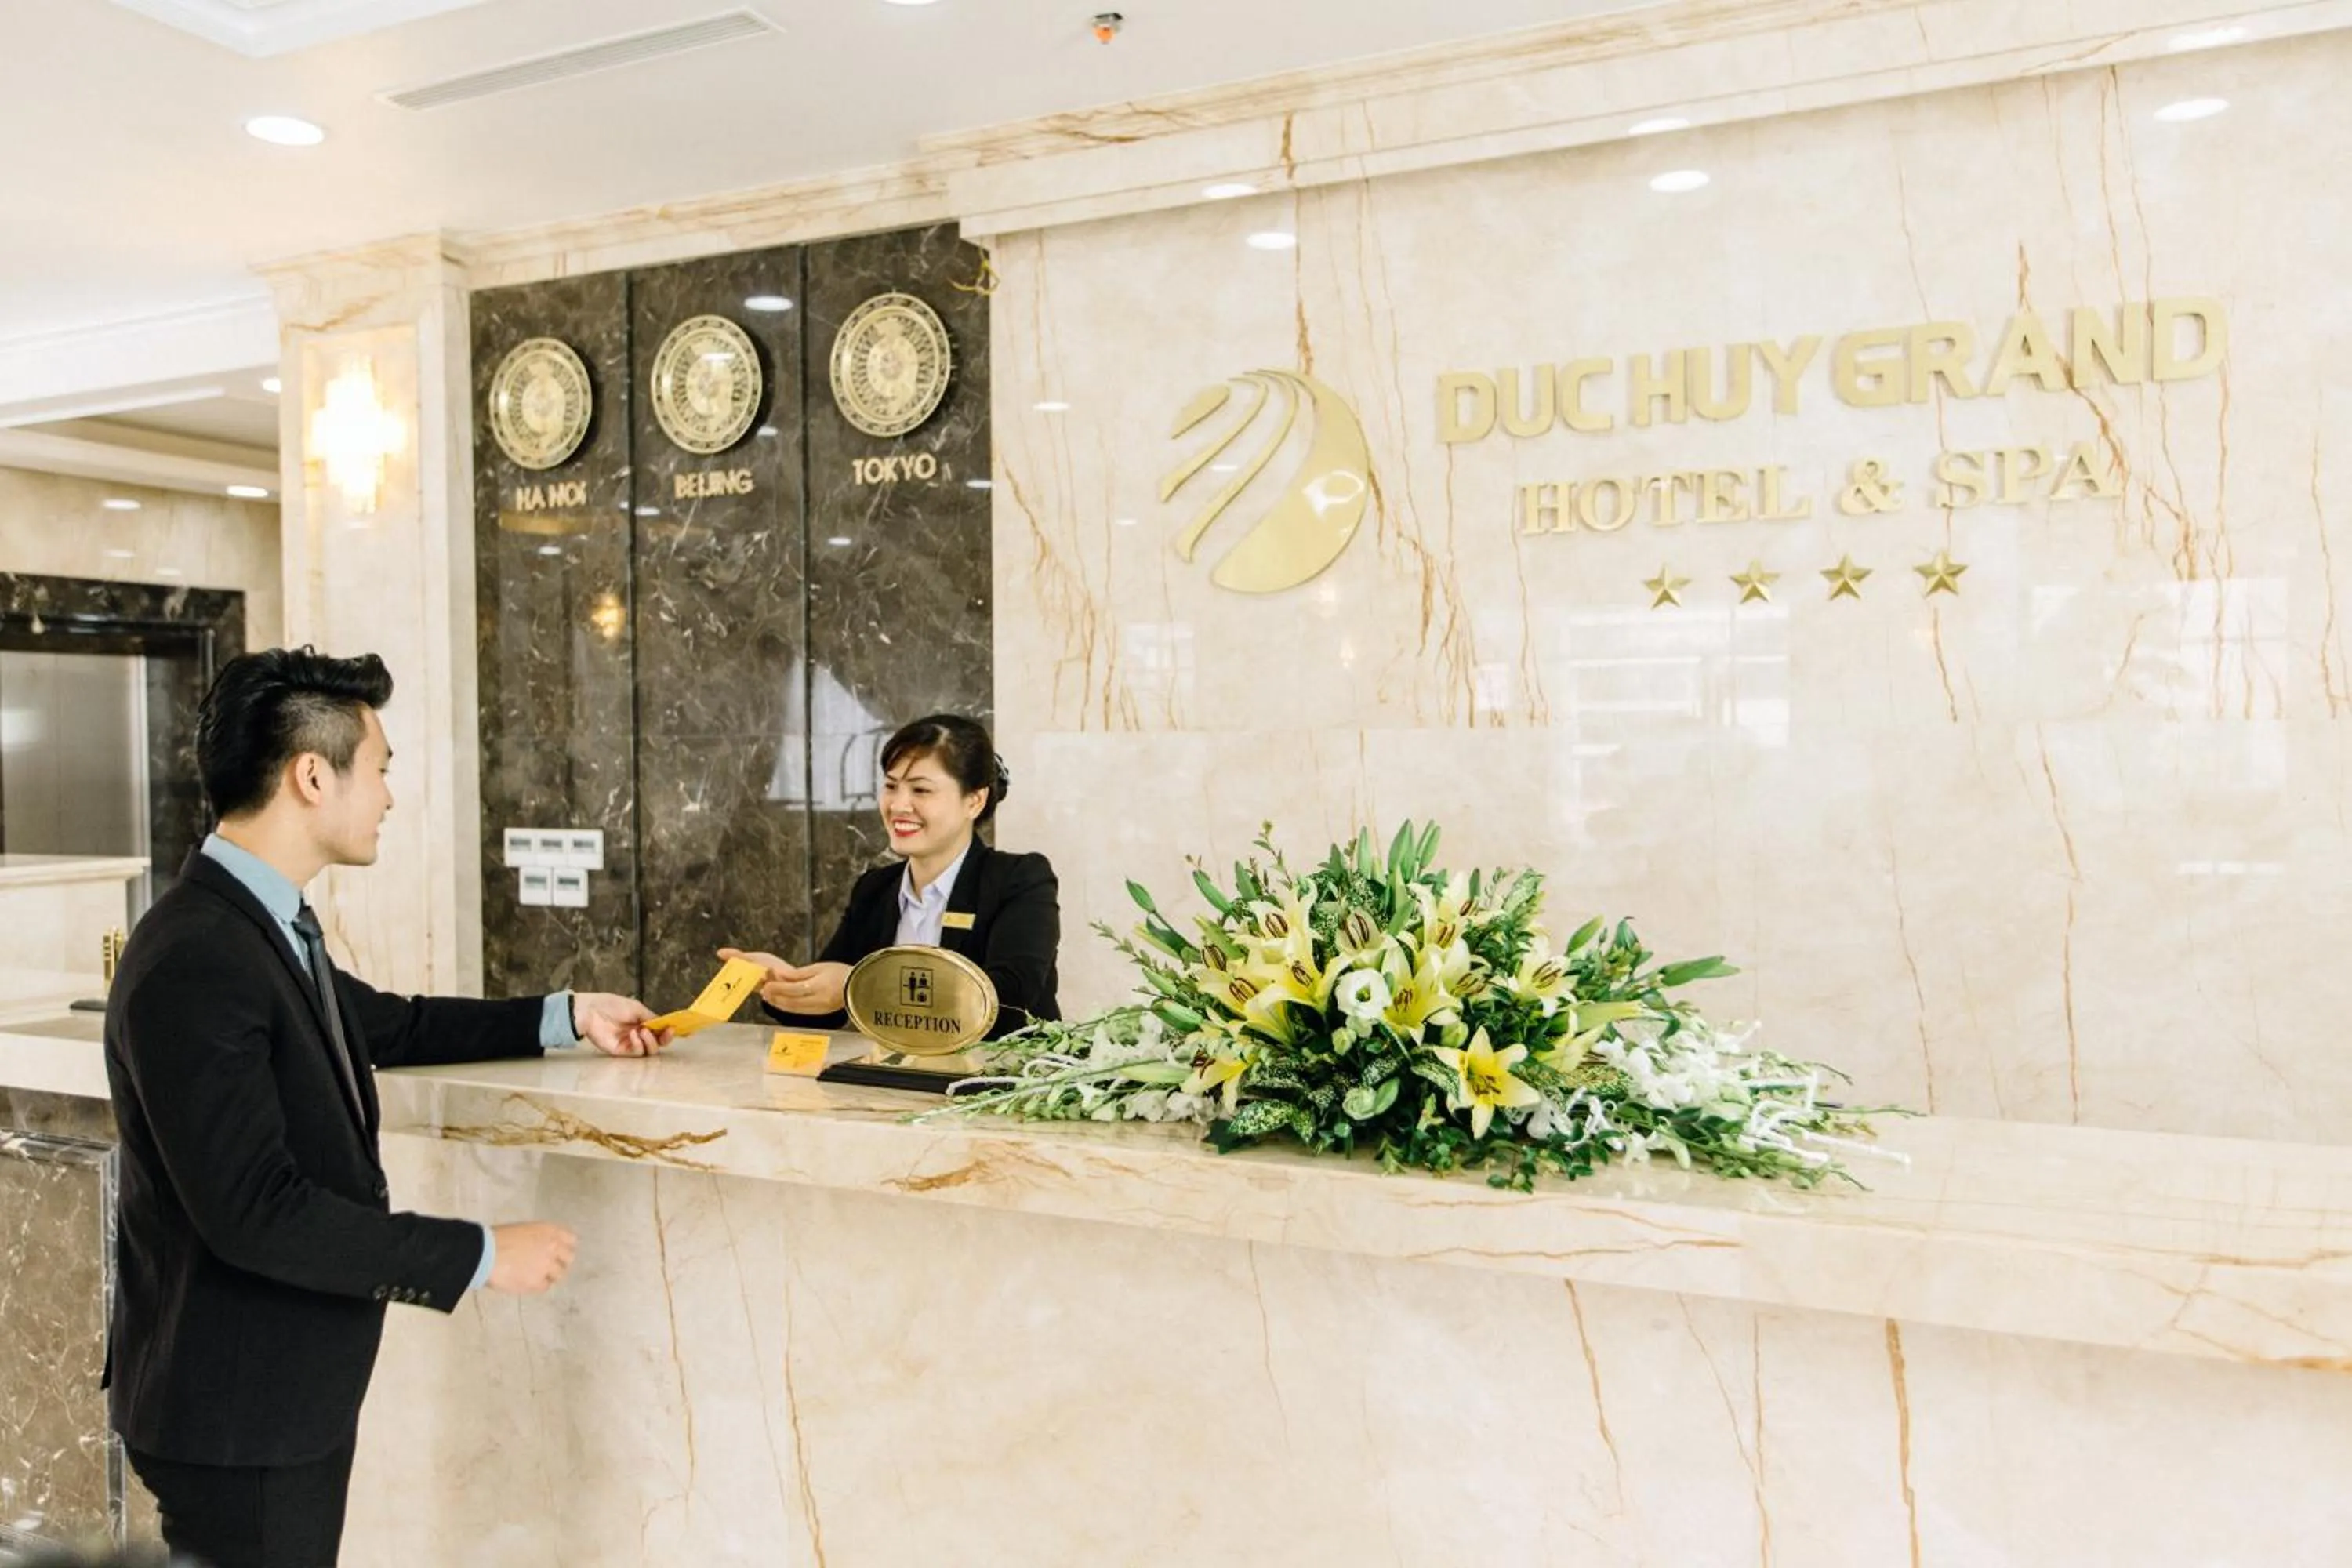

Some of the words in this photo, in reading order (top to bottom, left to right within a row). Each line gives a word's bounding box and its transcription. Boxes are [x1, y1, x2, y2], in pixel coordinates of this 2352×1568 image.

[1436, 357, 1613, 444] DUC
[1628, 335, 1823, 427] HUY
[1833, 296, 2227, 408] GRAND
[851, 452, 938, 485] TOKYO
[1516, 466, 1812, 536] HOTEL
[1839, 456, 1904, 516] &
[1933, 441, 2122, 510] SPA
[873, 1009, 961, 1035] RECEPTION
